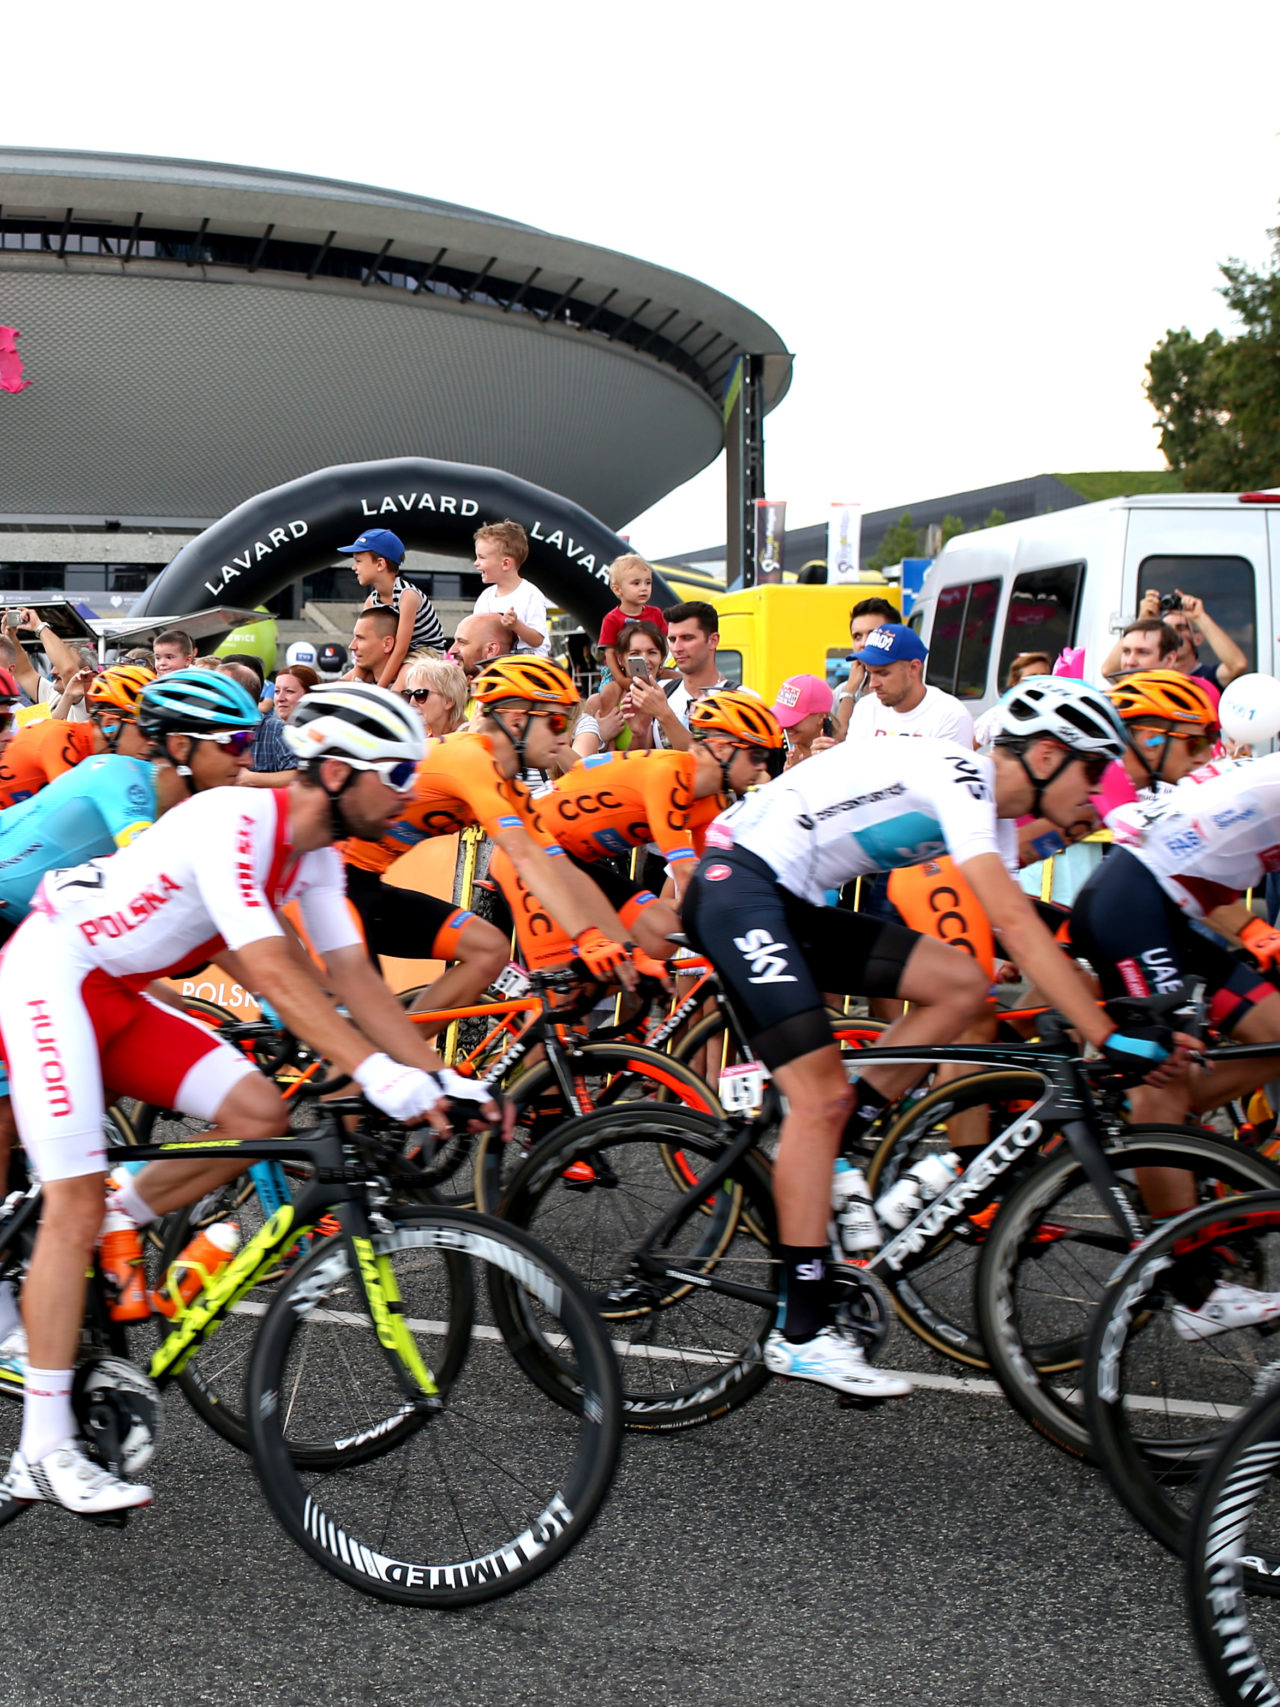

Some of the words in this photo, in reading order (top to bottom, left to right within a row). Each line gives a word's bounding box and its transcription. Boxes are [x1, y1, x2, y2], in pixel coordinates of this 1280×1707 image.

[360, 492, 479, 518] LAVARD
[204, 519, 308, 597] LAVARD
[530, 520, 612, 586] LAVAR
[558, 791, 622, 821] CCC
[77, 872, 184, 947] POLSKA
[182, 981, 260, 1008] POLSK
[1140, 946, 1185, 996] UAE
[884, 1119, 1043, 1272] PINARELLO
[384, 1538, 532, 1590] LIMITED
